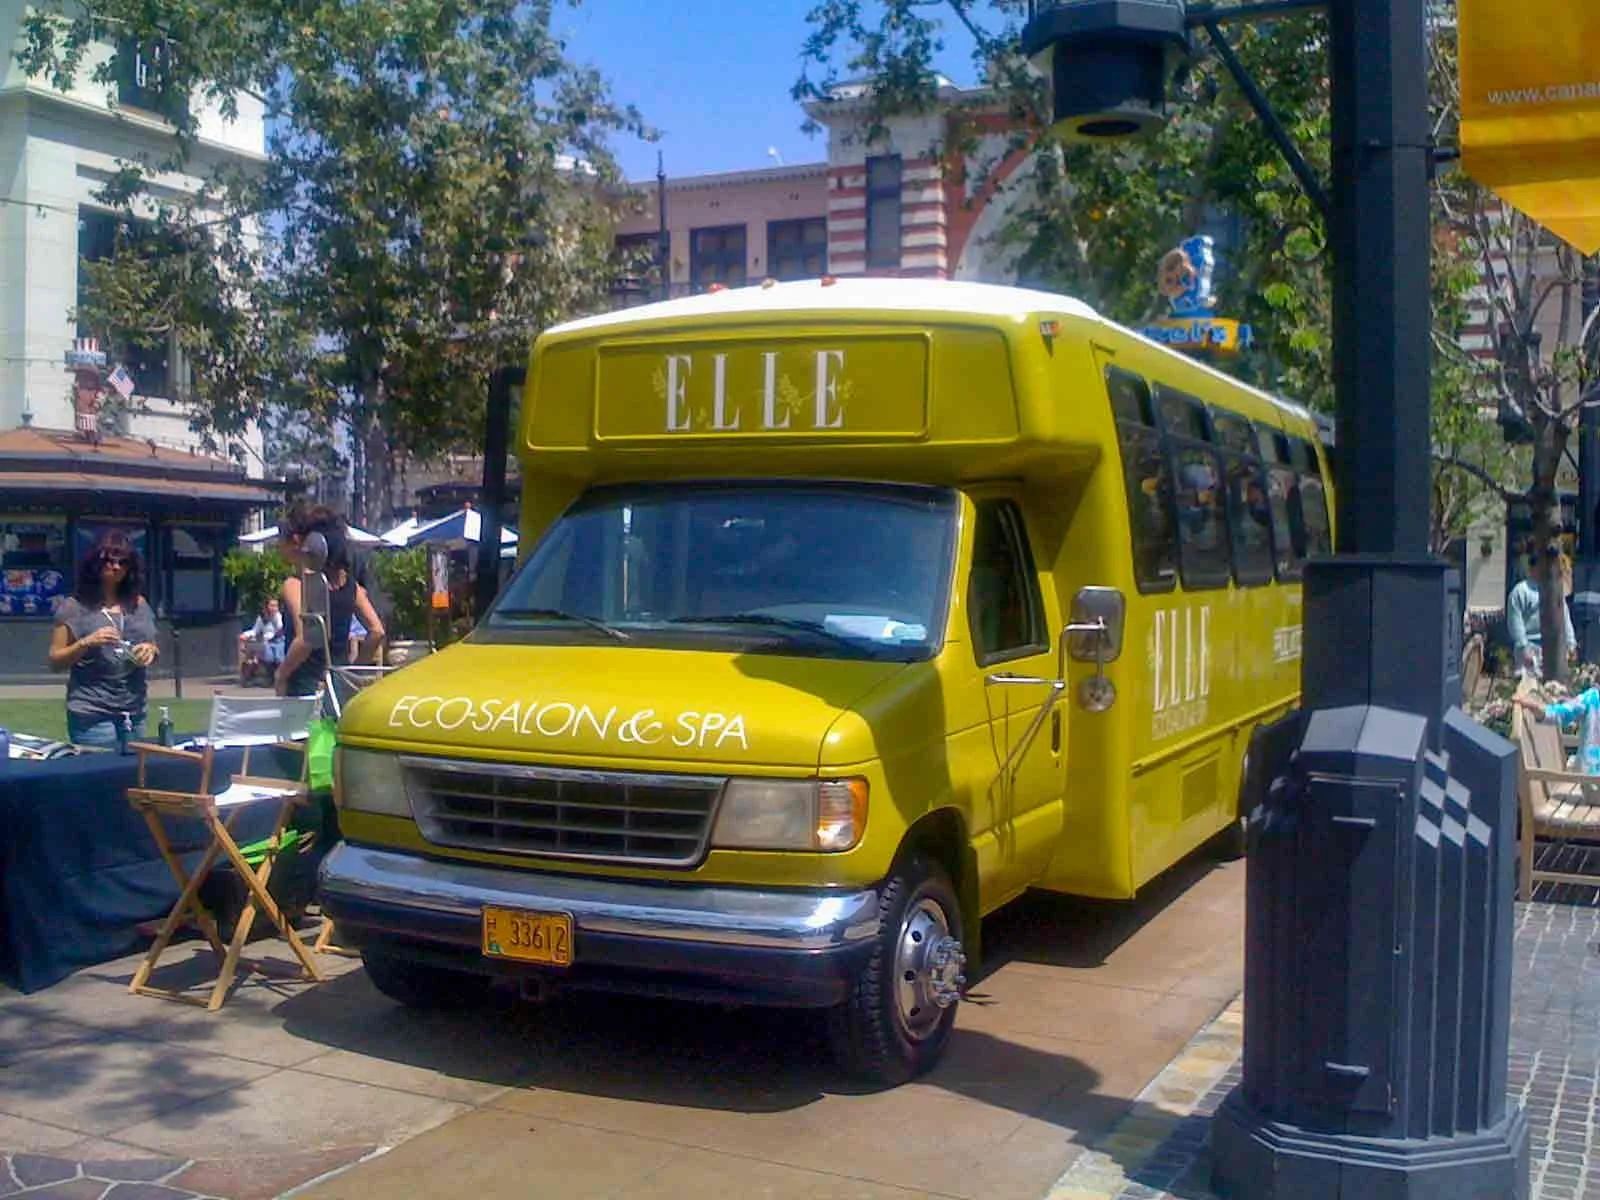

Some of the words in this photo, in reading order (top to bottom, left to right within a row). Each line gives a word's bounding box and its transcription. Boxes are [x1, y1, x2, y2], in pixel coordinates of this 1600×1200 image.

[665, 350, 847, 432] ELLE
[1153, 605, 1211, 713] ELLE
[389, 695, 617, 740] ECO-SALON
[618, 708, 666, 745] &
[672, 710, 749, 750] SPA
[511, 918, 568, 954] 33612
